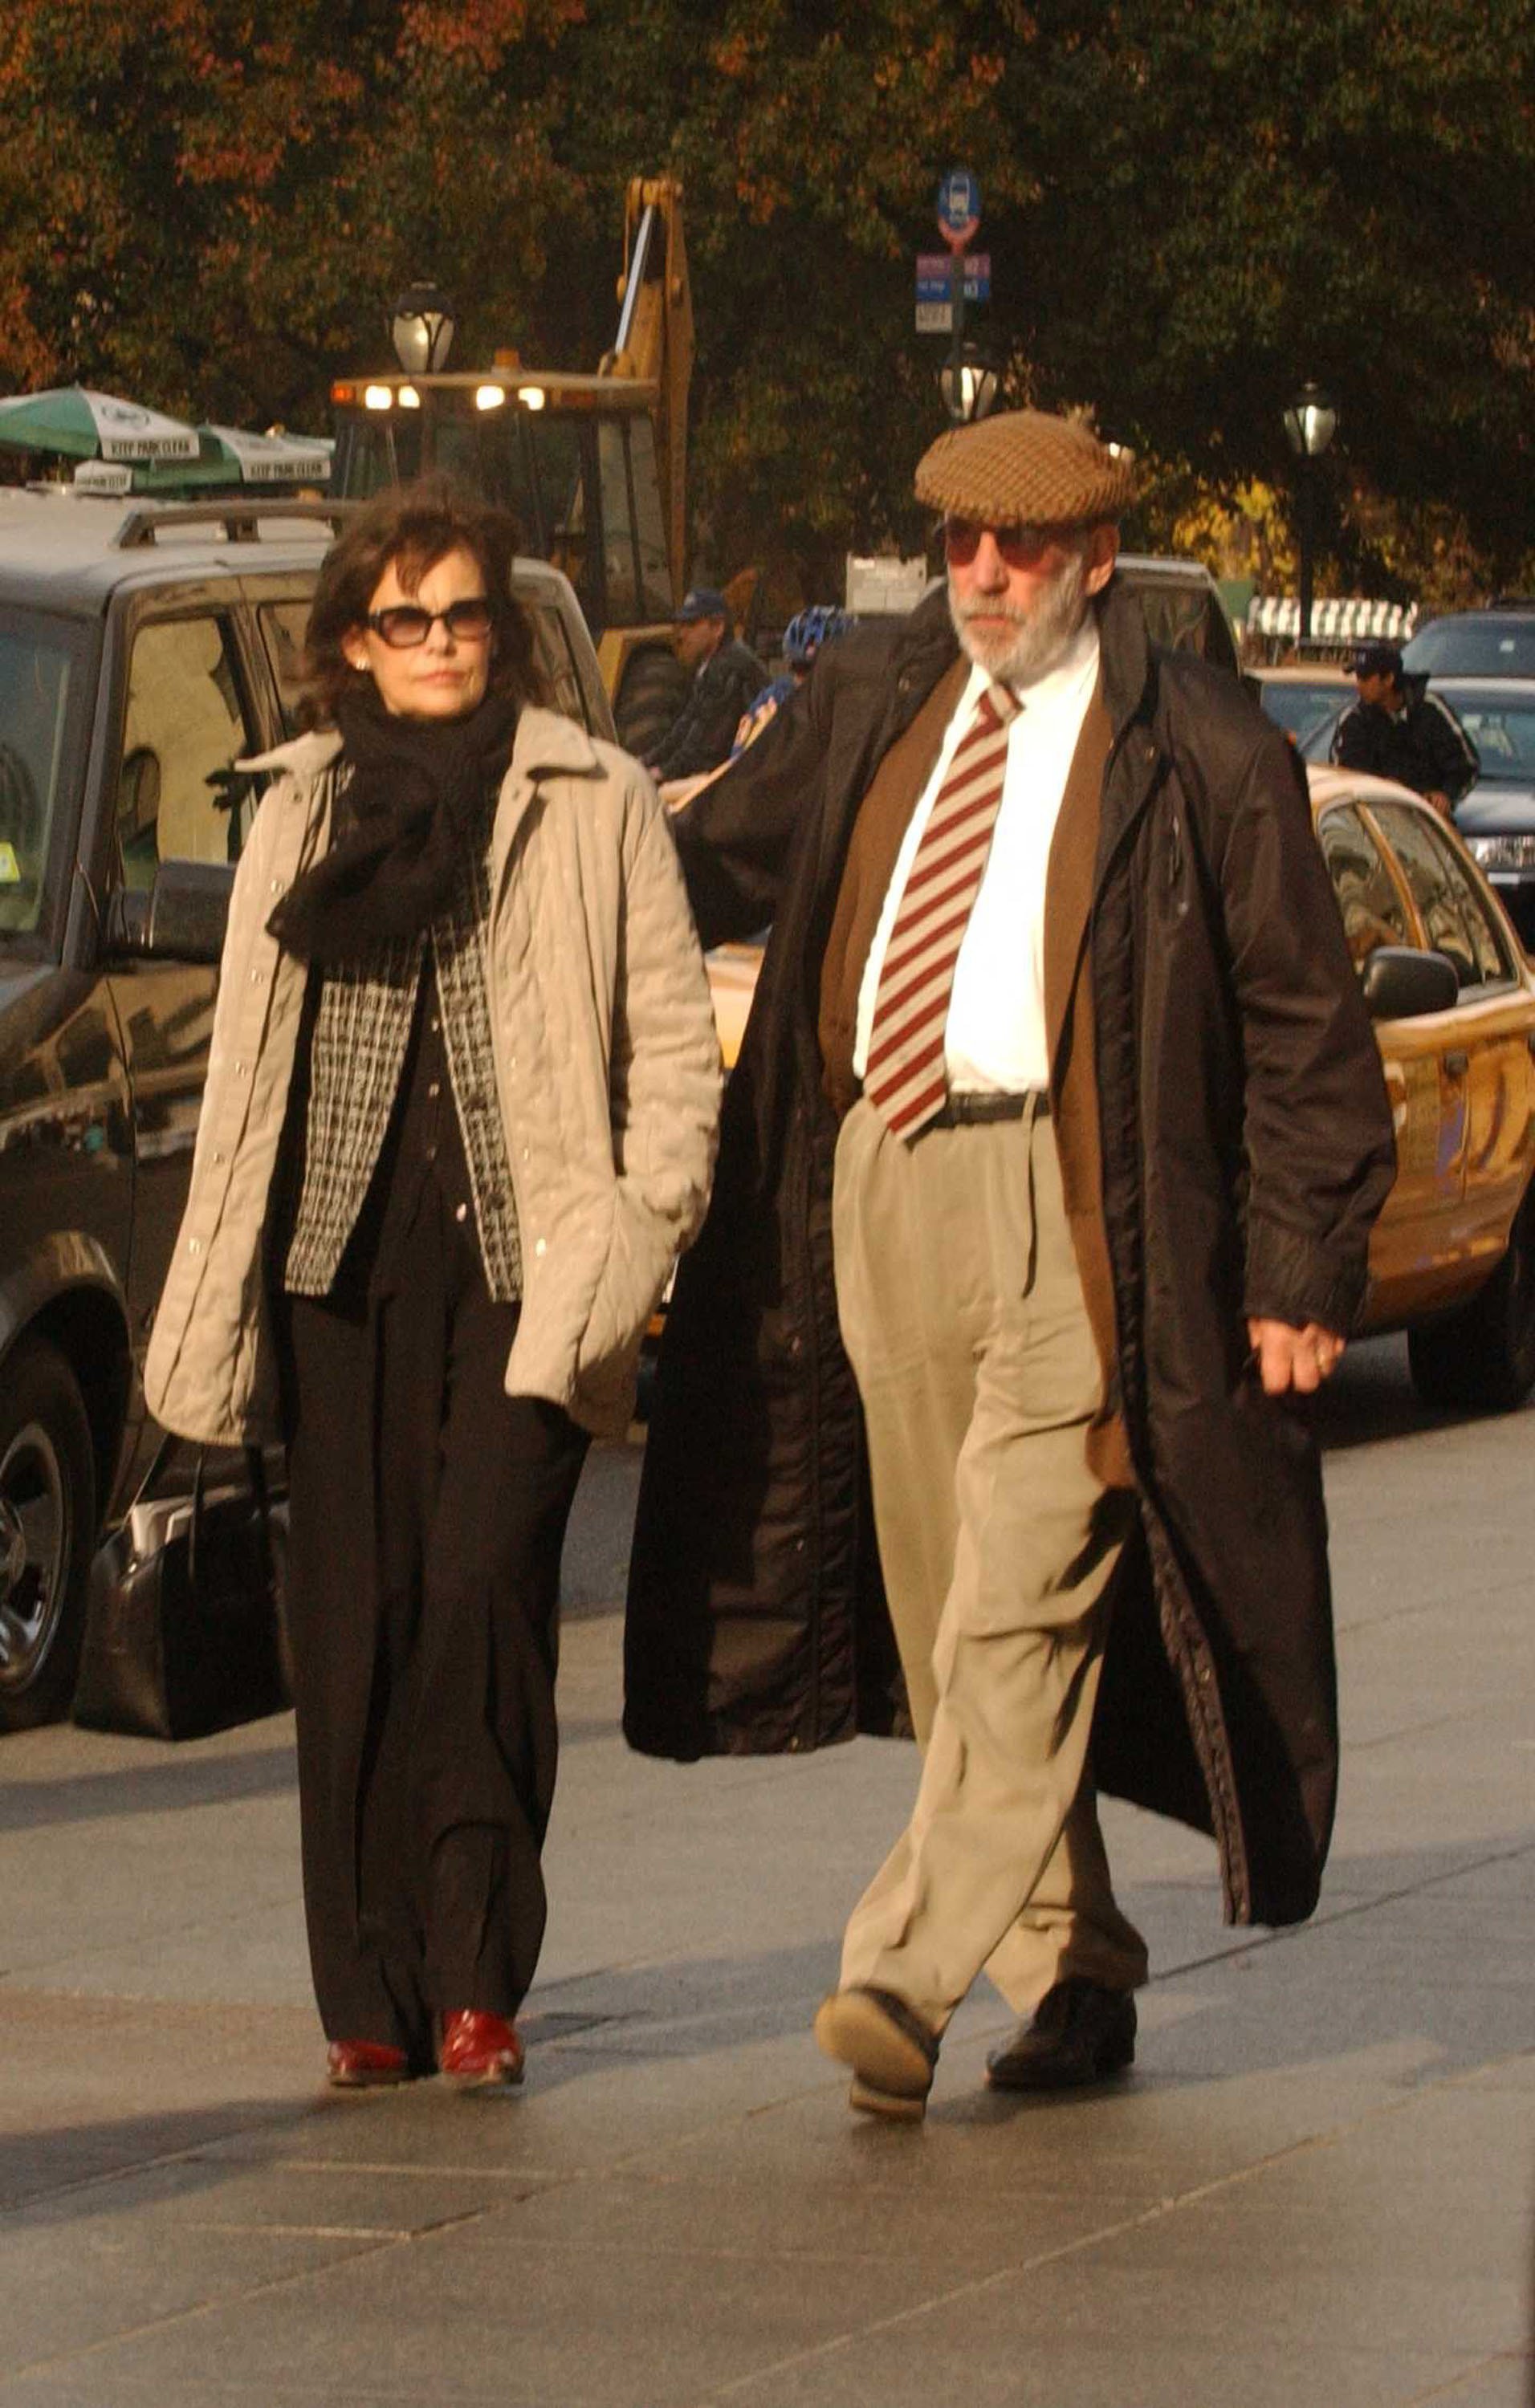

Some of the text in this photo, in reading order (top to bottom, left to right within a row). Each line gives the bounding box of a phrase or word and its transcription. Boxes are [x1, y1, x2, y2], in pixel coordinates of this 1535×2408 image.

[111, 438, 190, 456] KEEP PARK CLEAN
